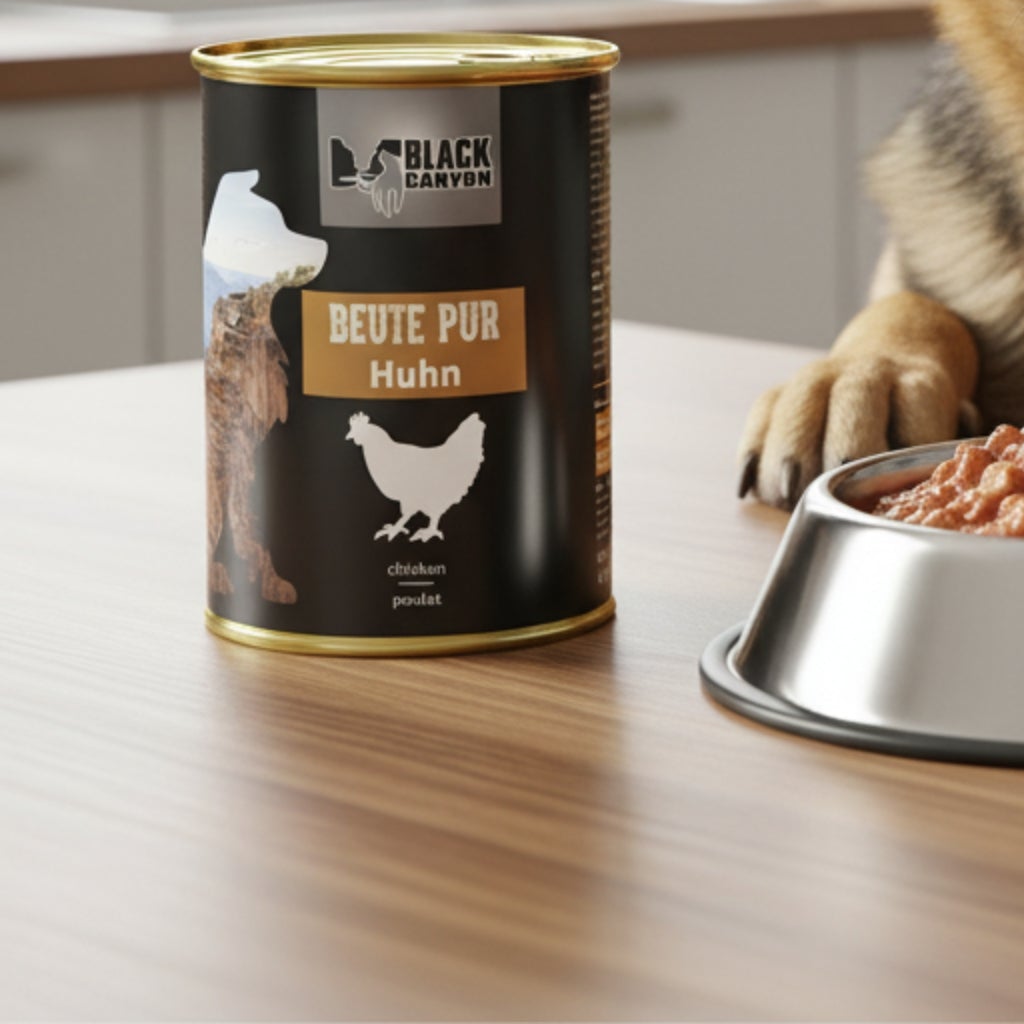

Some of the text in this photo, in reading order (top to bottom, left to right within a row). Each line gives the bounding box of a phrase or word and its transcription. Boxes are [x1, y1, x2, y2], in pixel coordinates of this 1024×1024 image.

[404, 137, 491, 170] BLACK
[328, 300, 500, 345] BEUTE PUR
[370, 358, 461, 389] Huhn
